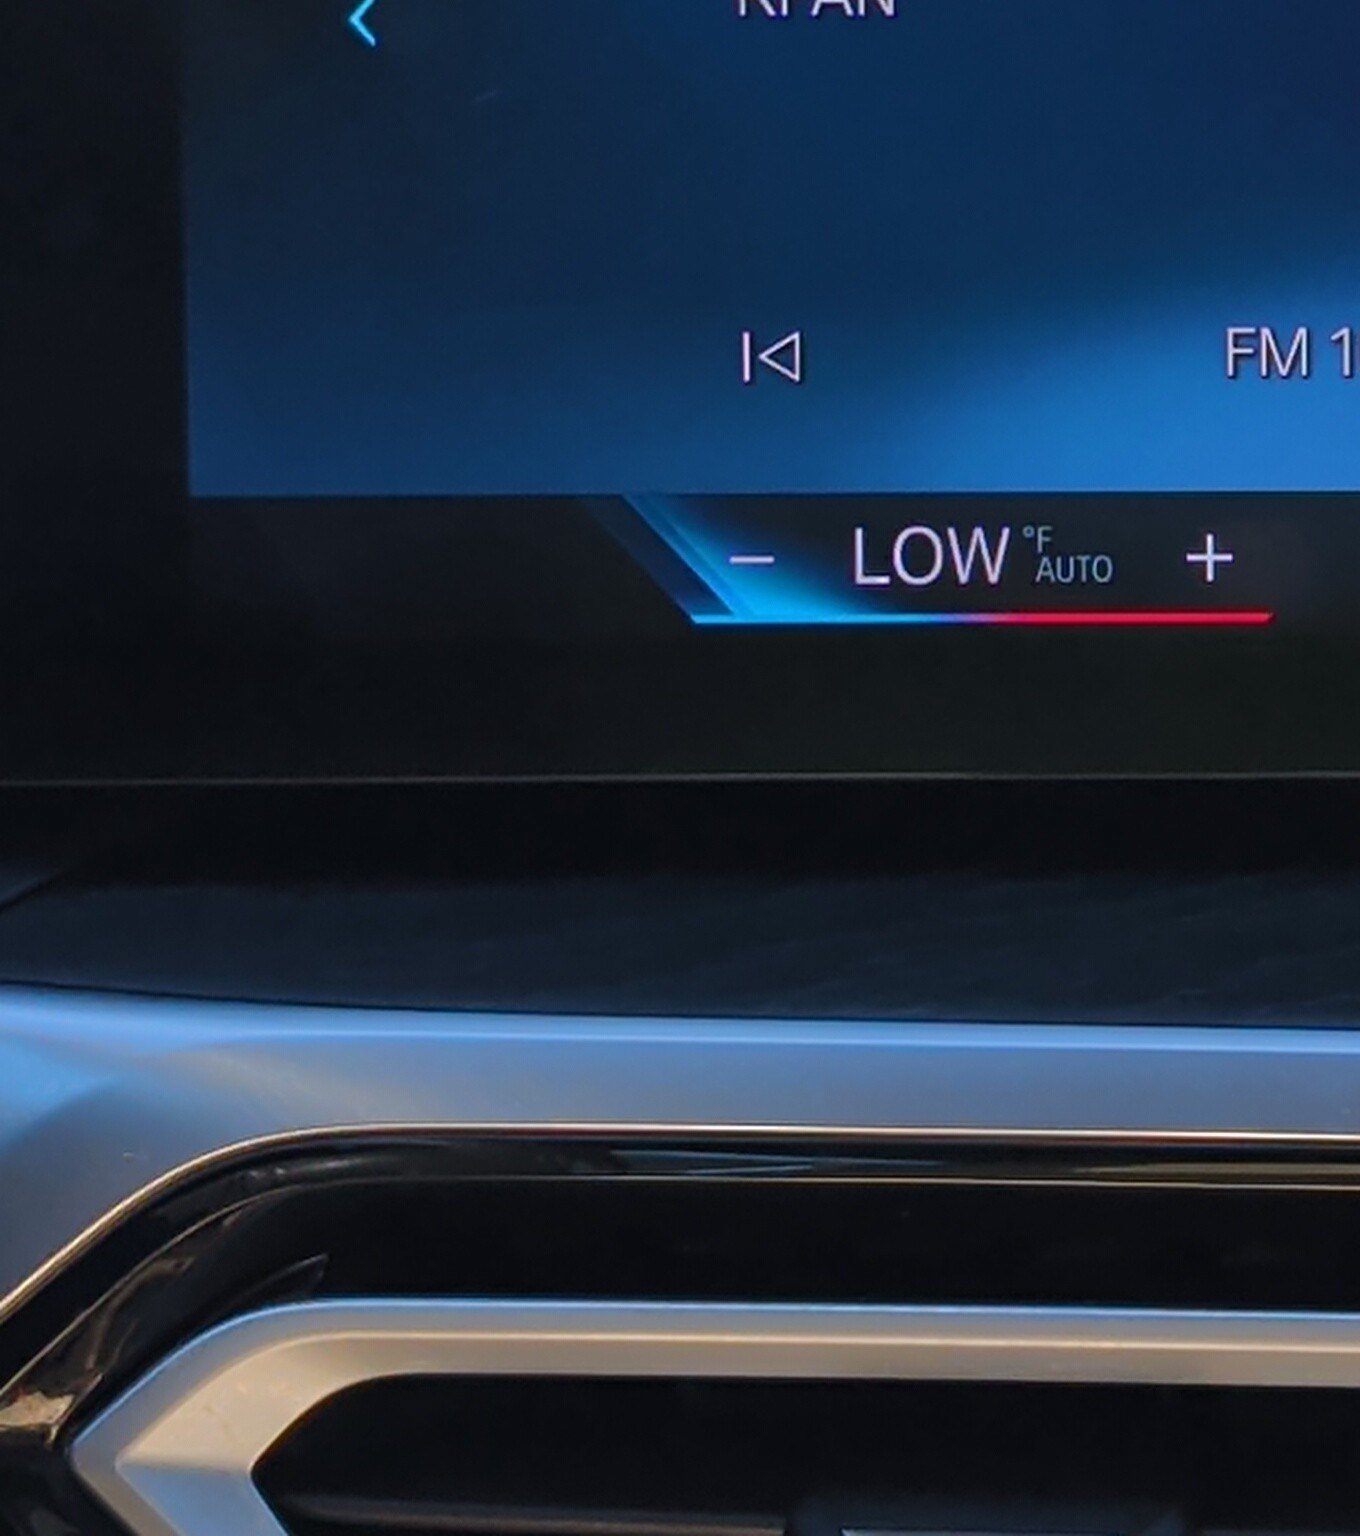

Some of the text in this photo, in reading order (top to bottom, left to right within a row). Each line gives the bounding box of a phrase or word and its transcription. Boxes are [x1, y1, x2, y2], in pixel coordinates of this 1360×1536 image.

[1223, 326, 1311, 379] FM
[854, 526, 1011, 586] LOW
[1034, 555, 1114, 584] AUTO
